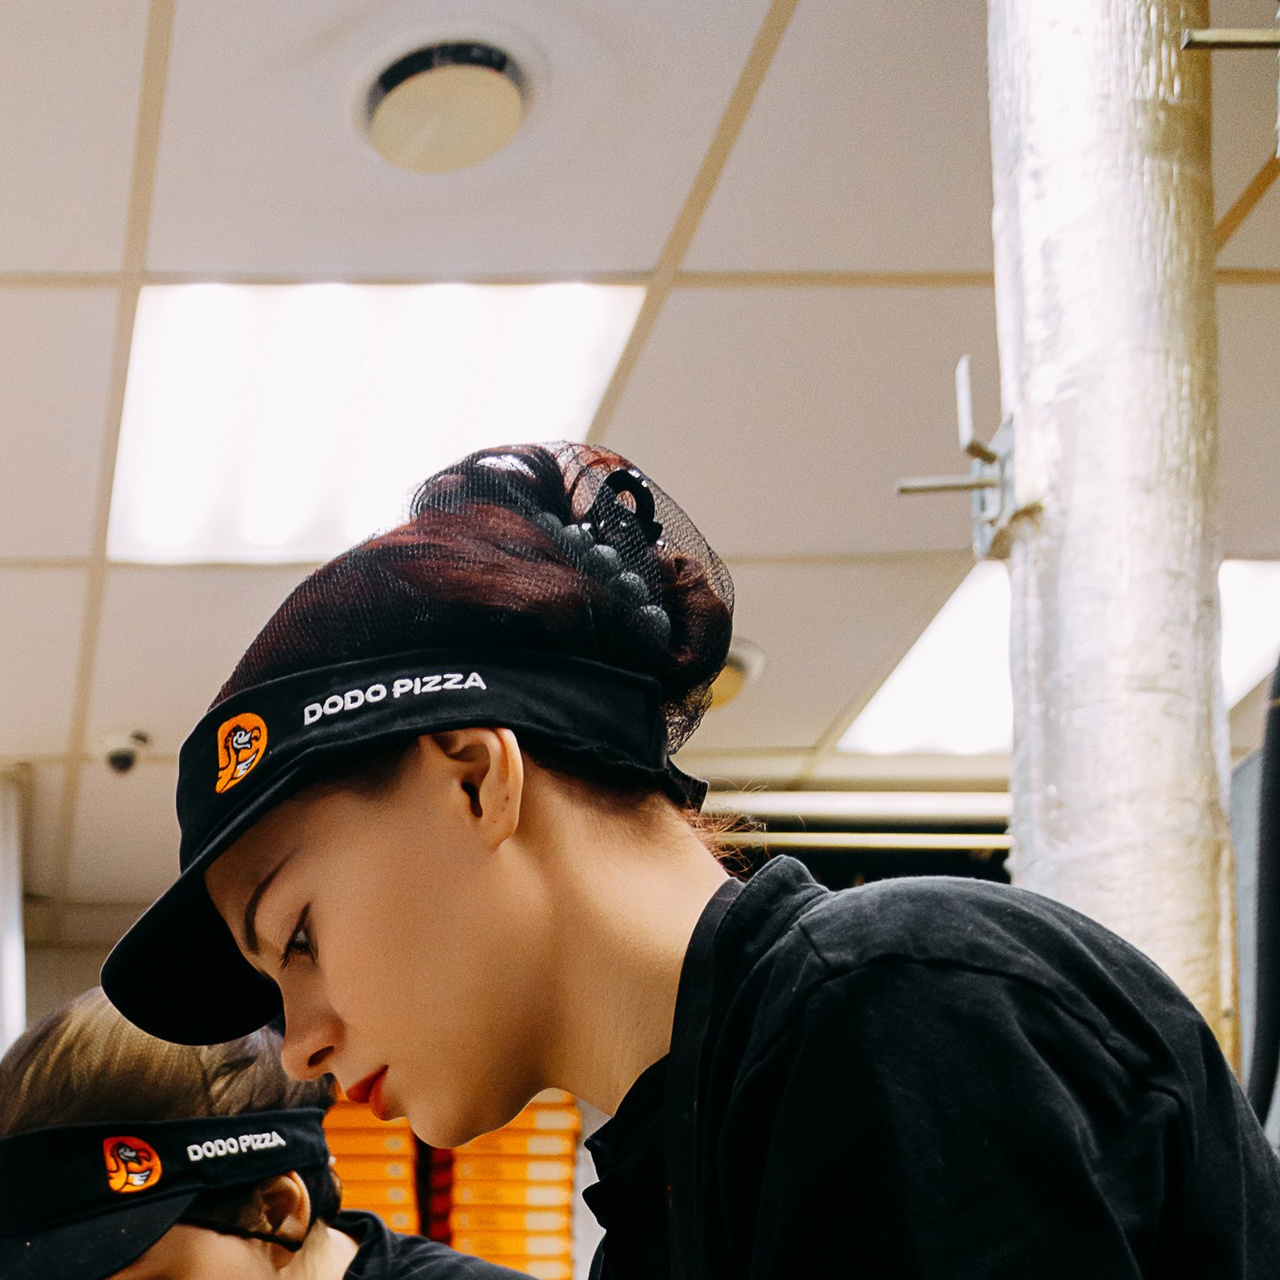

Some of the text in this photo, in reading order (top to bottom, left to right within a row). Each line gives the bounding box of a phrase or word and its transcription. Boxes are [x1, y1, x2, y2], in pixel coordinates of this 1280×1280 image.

[304, 671, 487, 726] DODO PIZZA
[186, 1131, 287, 1162] DODO PIZZA
